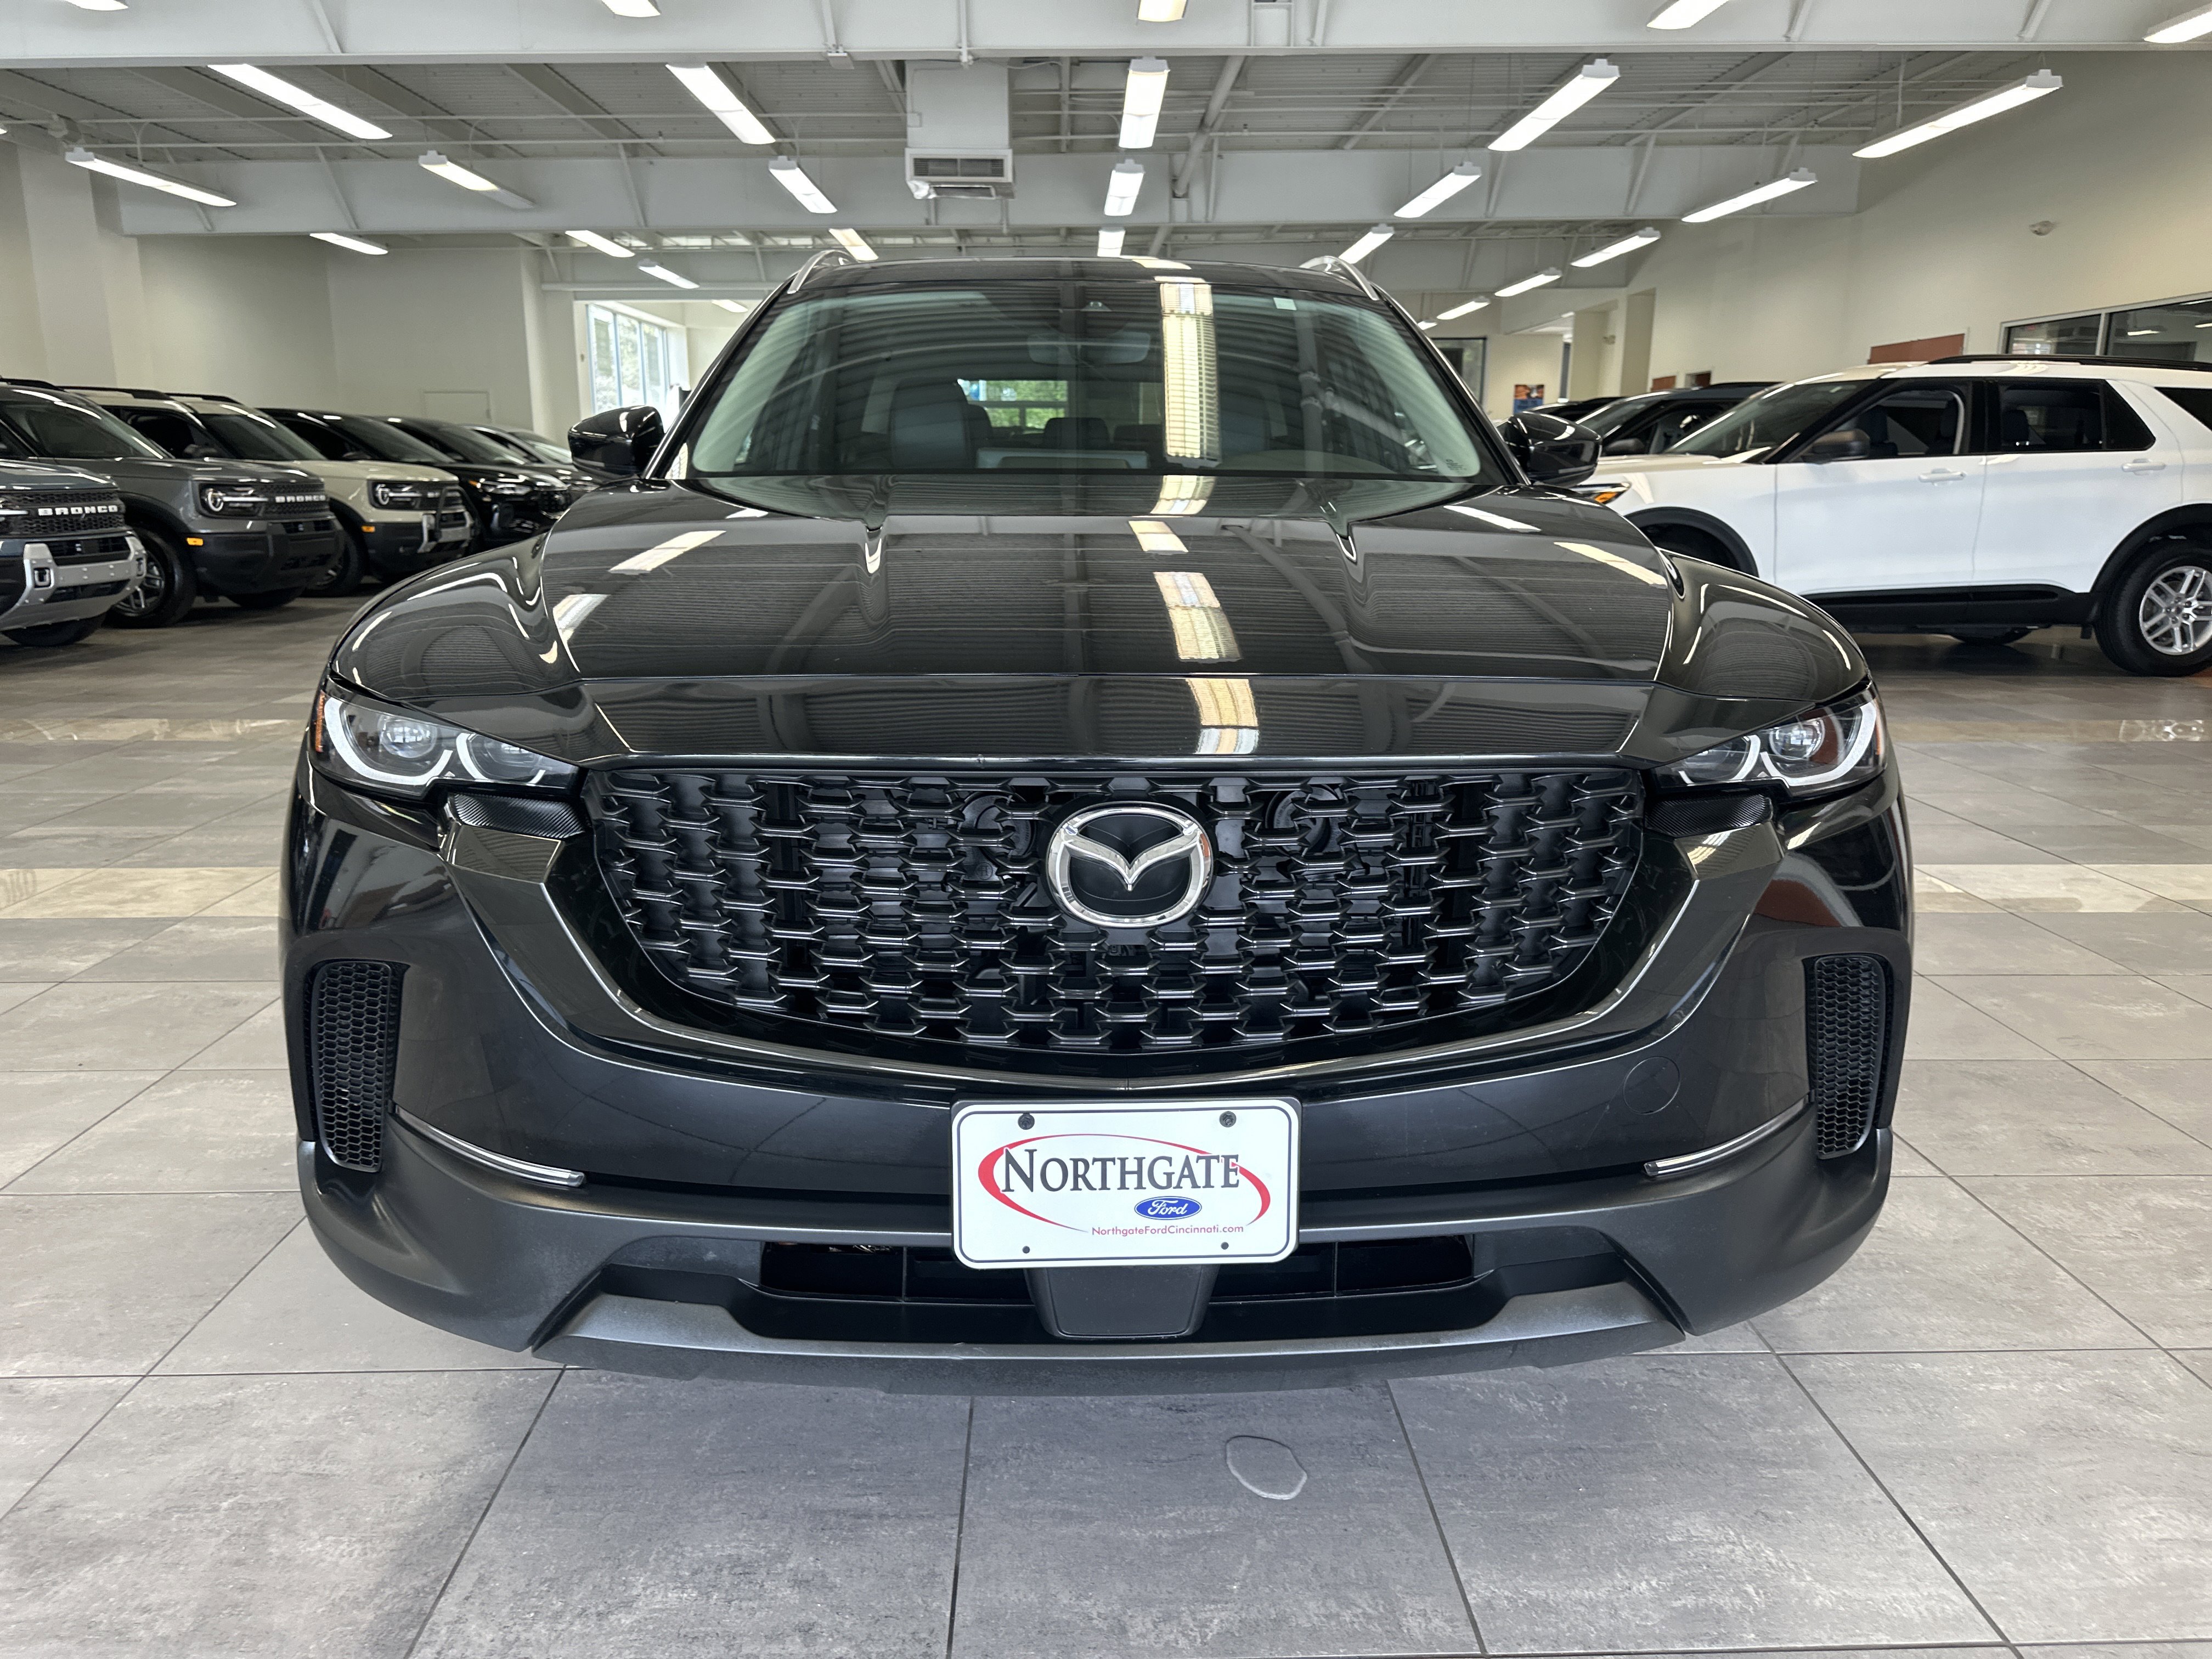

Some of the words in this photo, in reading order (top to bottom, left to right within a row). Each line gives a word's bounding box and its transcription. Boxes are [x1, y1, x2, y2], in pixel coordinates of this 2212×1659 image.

[38, 505, 118, 516] BRONCO
[1001, 1148, 1239, 1192] NORTHGATE
[1147, 1199, 1188, 1215] Ford
[1092, 1224, 1244, 1237] NorthgateFordCincinnati.com
